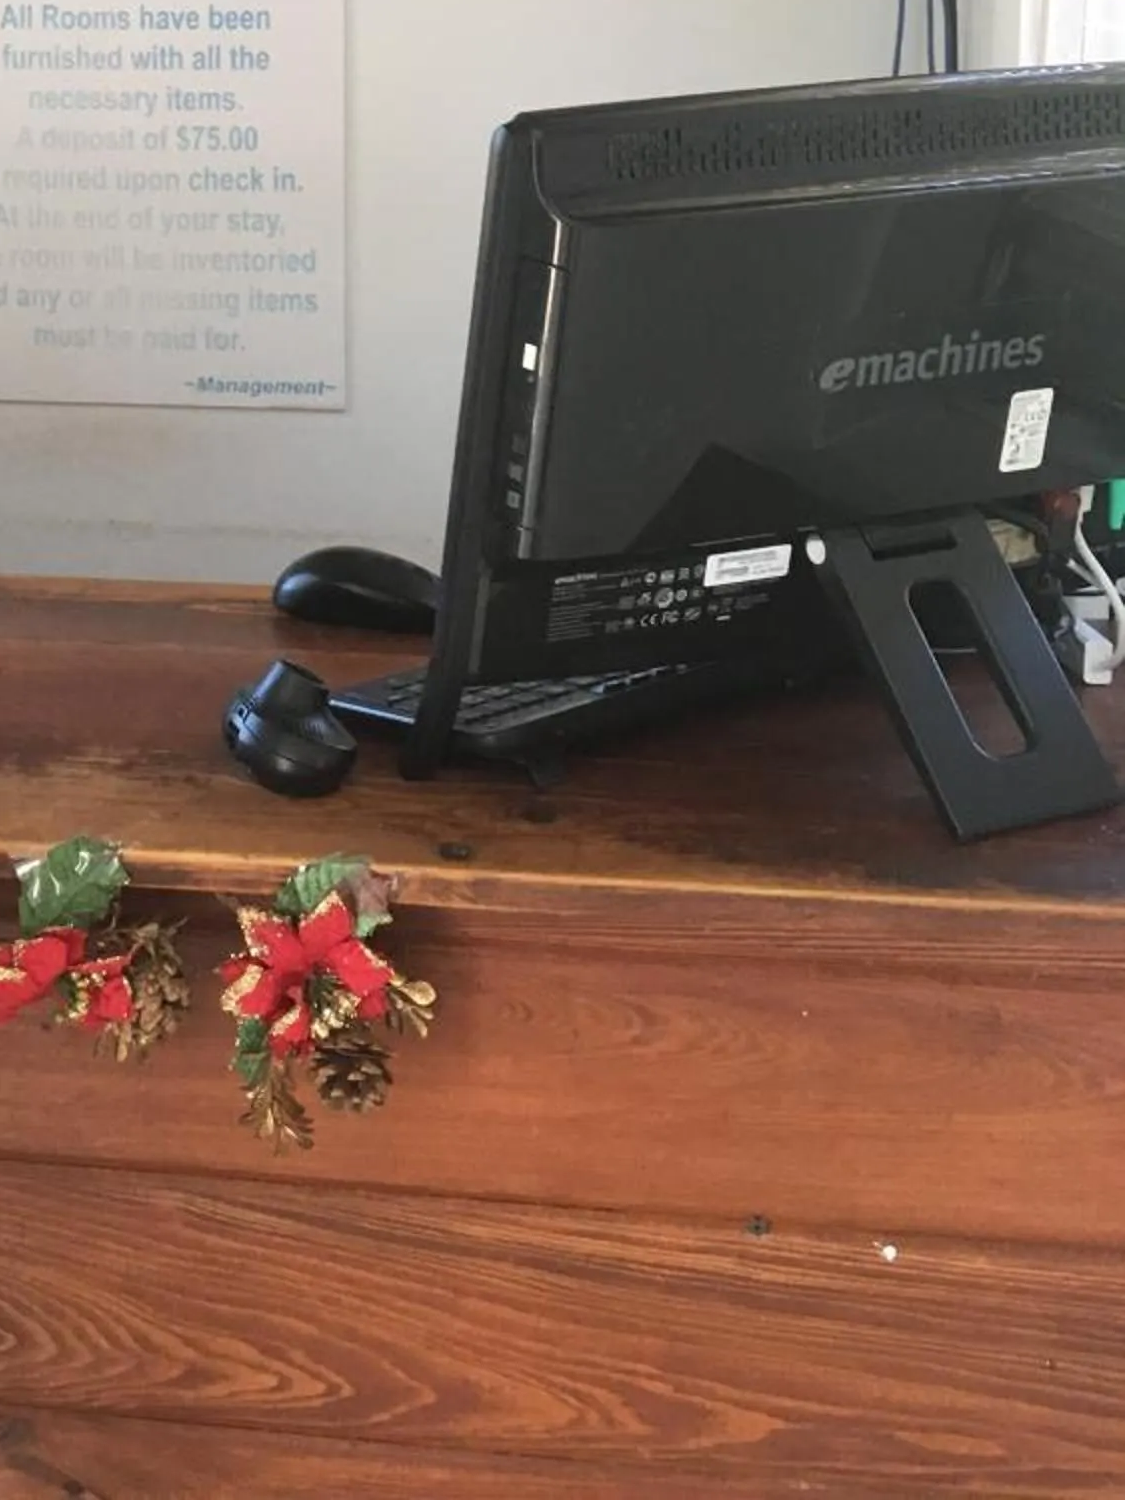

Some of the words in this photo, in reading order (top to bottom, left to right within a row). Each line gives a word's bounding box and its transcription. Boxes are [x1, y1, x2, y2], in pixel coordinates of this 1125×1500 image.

[0, 4, 33, 30] All
[42, 4, 131, 31] Rooms
[140, 4, 199, 31] have
[208, 4, 270, 31] been
[2, 44, 122, 71] furnished
[131, 44, 183, 71] with
[192, 44, 221, 71] all
[230, 44, 270, 71] the
[29, 90, 158, 117] necessary
[166, 86, 244, 112] items.
[15, 127, 34, 150] A
[42, 125, 135, 157] deposit
[144, 126, 169, 151] of
[176, 125, 259, 153] $75.00
[2, 167, 107, 196] required
[116, 172, 179, 198] upon
[188, 166, 264, 192] check
[273, 167, 304, 193] in.
[74, 206, 120, 231] end
[127, 207, 154, 231] of
[160, 213, 218, 237] your
[227, 210, 285, 238] stay,
[173, 247, 316, 274] inventoried
[15, 289, 60, 313] any
[69, 289, 93, 310] or
[248, 287, 318, 313] items
[33, 326, 96, 350] must
[205, 328, 246, 352] for.
[819, 330, 1046, 393] emachines
